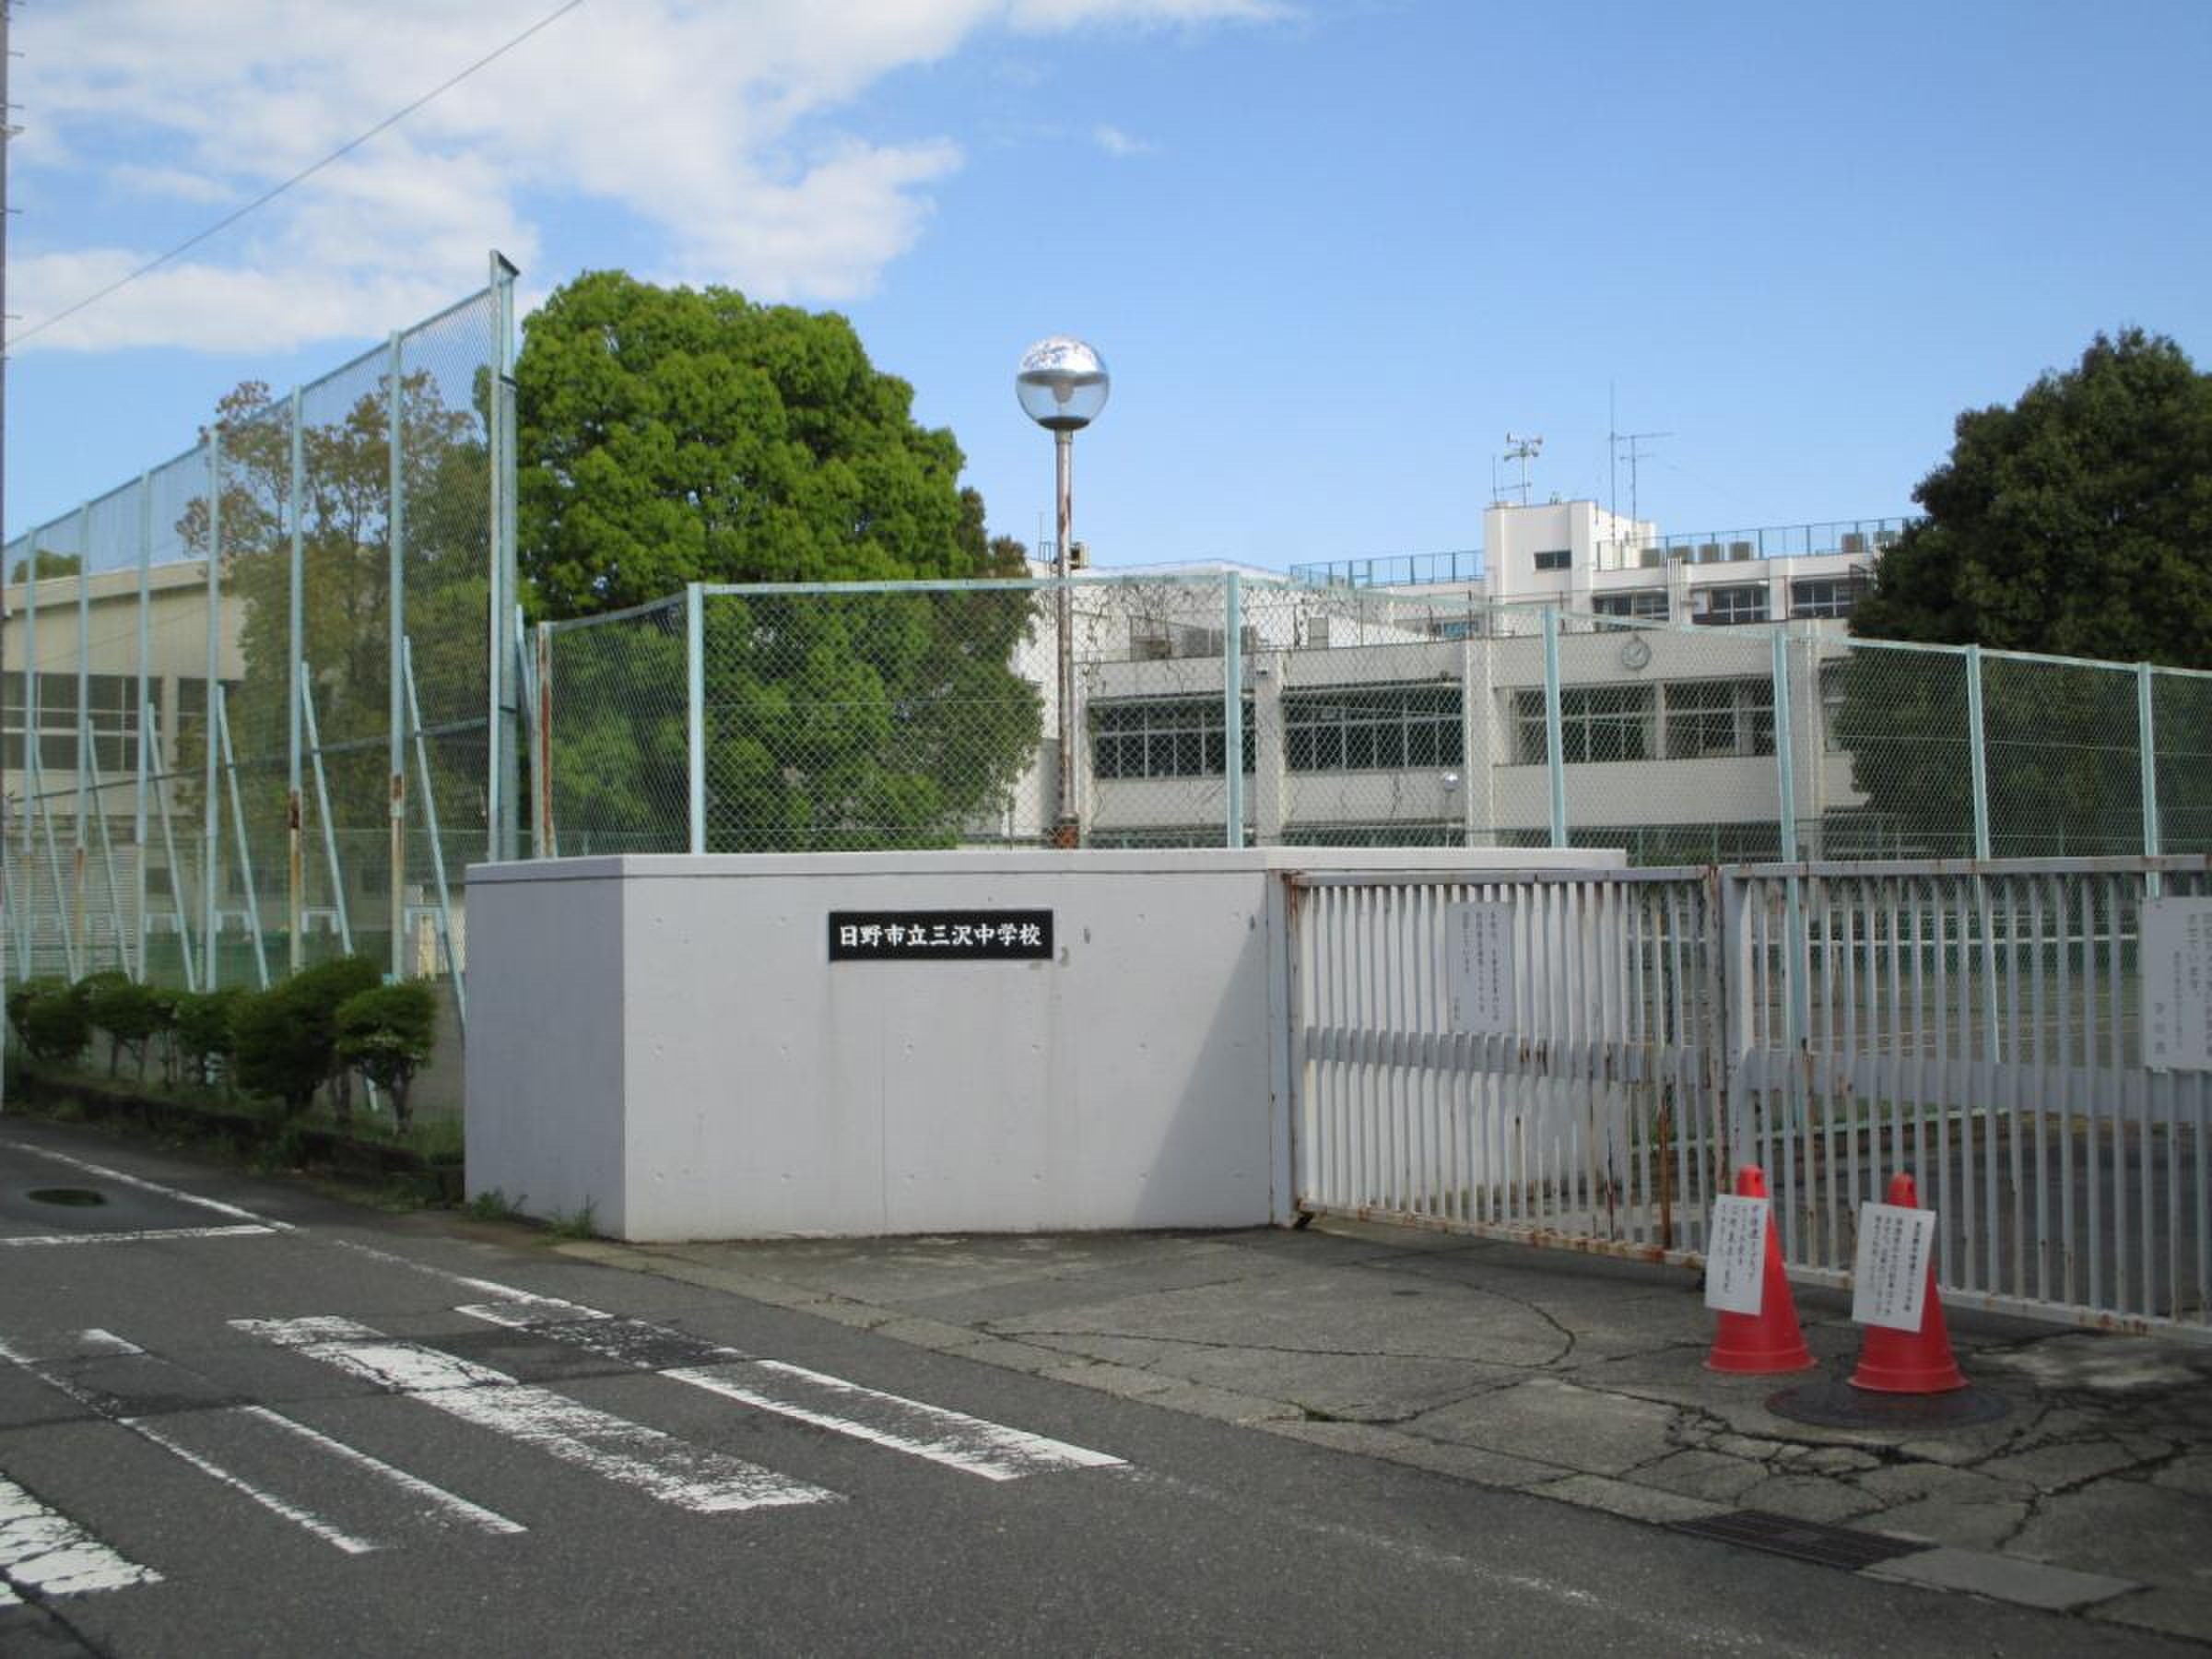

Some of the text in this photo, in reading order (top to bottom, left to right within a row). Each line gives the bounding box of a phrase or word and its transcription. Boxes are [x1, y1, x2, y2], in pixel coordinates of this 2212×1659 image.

[840, 923, 1042, 947] 日野市立三沢中学校
